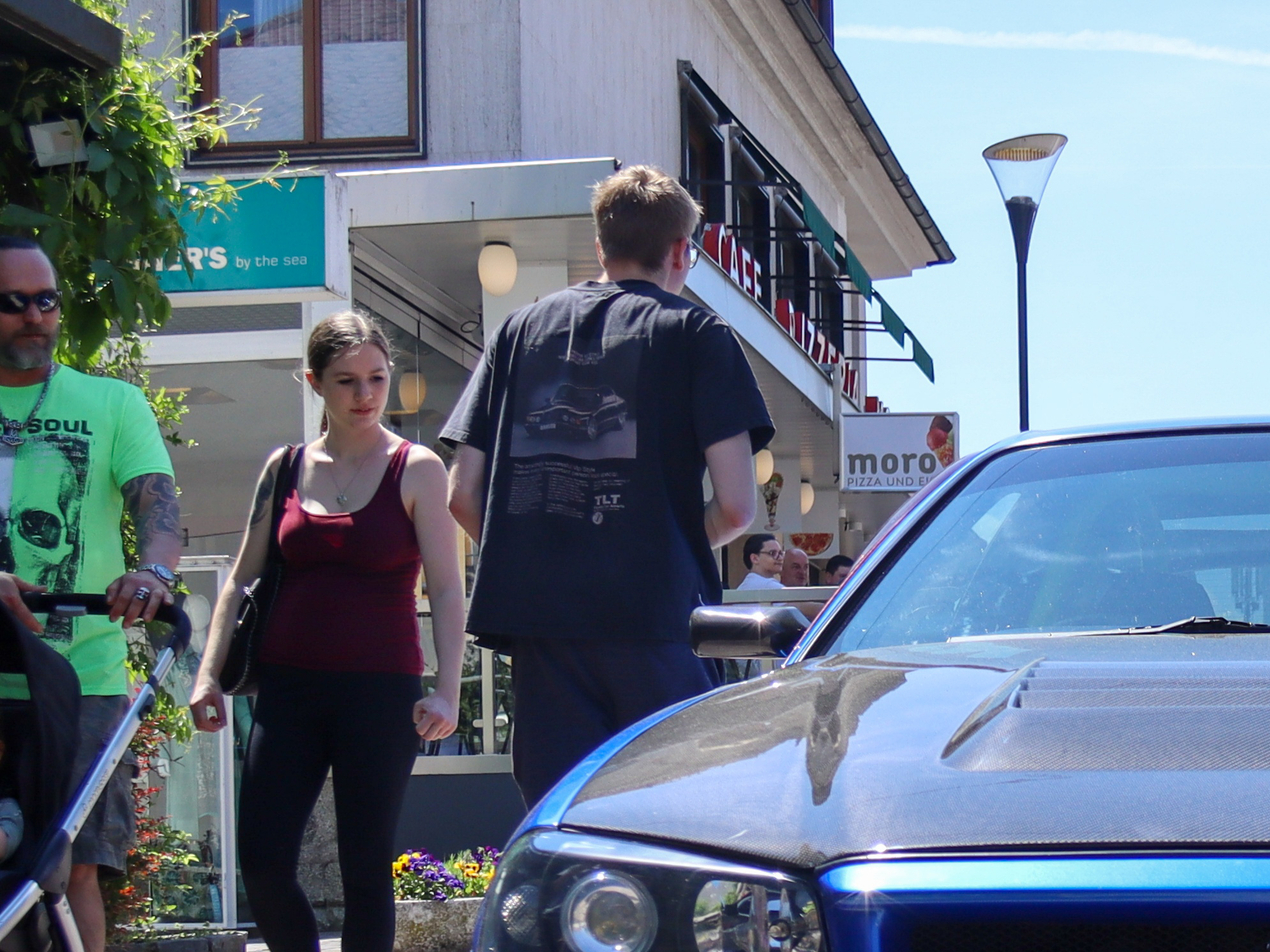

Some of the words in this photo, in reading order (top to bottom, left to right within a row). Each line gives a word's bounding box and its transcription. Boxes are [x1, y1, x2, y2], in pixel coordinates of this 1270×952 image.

[235, 256, 251, 270] by
[255, 254, 278, 267] the
[283, 255, 308, 267] sea
[27, 418, 93, 436] SOUL
[847, 453, 937, 475] moro
[847, 477, 882, 487] PIZZA
[887, 477, 914, 487] UND
[594, 494, 621, 505] TLT
